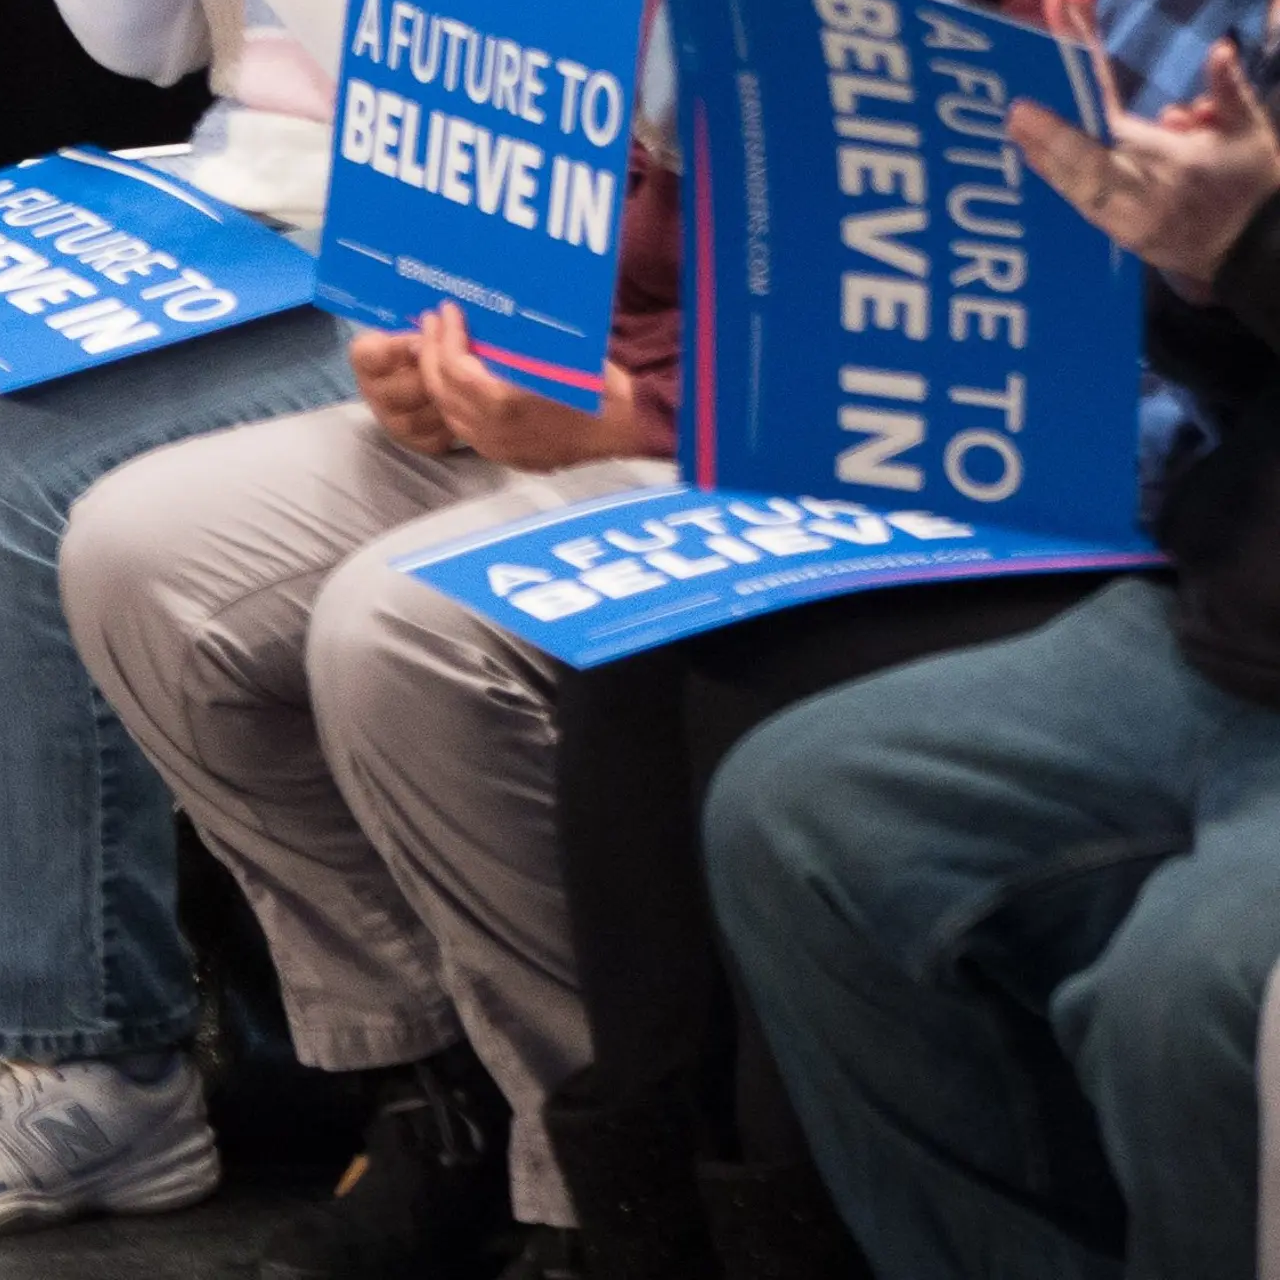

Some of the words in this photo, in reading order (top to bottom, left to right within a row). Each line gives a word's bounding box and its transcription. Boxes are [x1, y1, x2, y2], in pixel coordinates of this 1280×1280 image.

[914, 7, 994, 53] A
[554, 58, 625, 149] TO
[341, 77, 545, 231] BELIEVE
[545, 152, 617, 257] IN
[927, 54, 1030, 352] FUTURE
[0, 186, 179, 286] FUTURE
[139, 268, 240, 325] TO
[43, 296, 164, 357] IN
[834, 362, 931, 493] IN
[942, 371, 1028, 504] TO
[486, 561, 552, 598] A
[507, 508, 976, 622] BELIEVE
